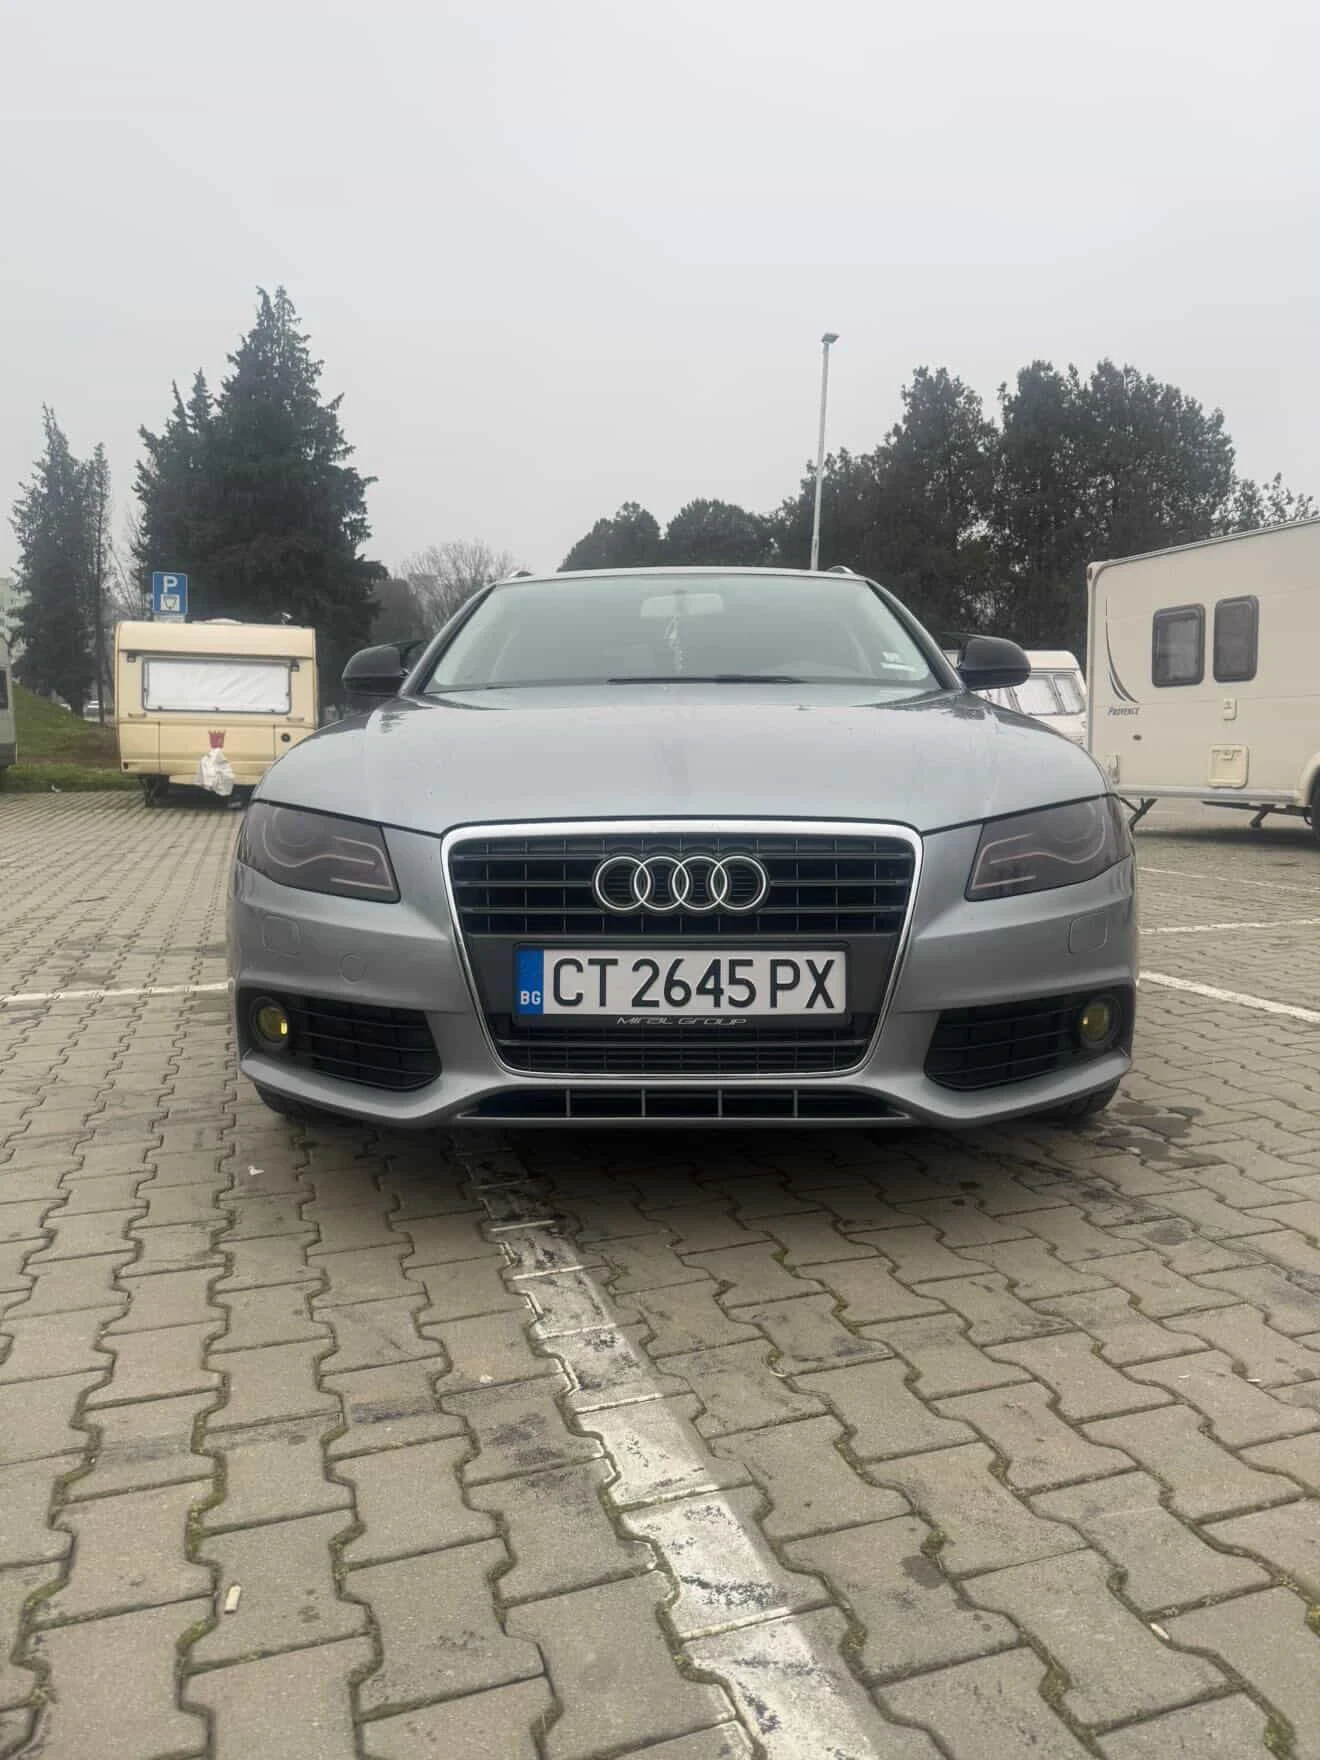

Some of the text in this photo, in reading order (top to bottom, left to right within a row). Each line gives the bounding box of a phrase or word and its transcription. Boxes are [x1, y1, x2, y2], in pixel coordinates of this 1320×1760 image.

[163, 575, 178, 593] P
[553, 958, 835, 1009] CT 2645 PX
[519, 991, 541, 1005] BG
